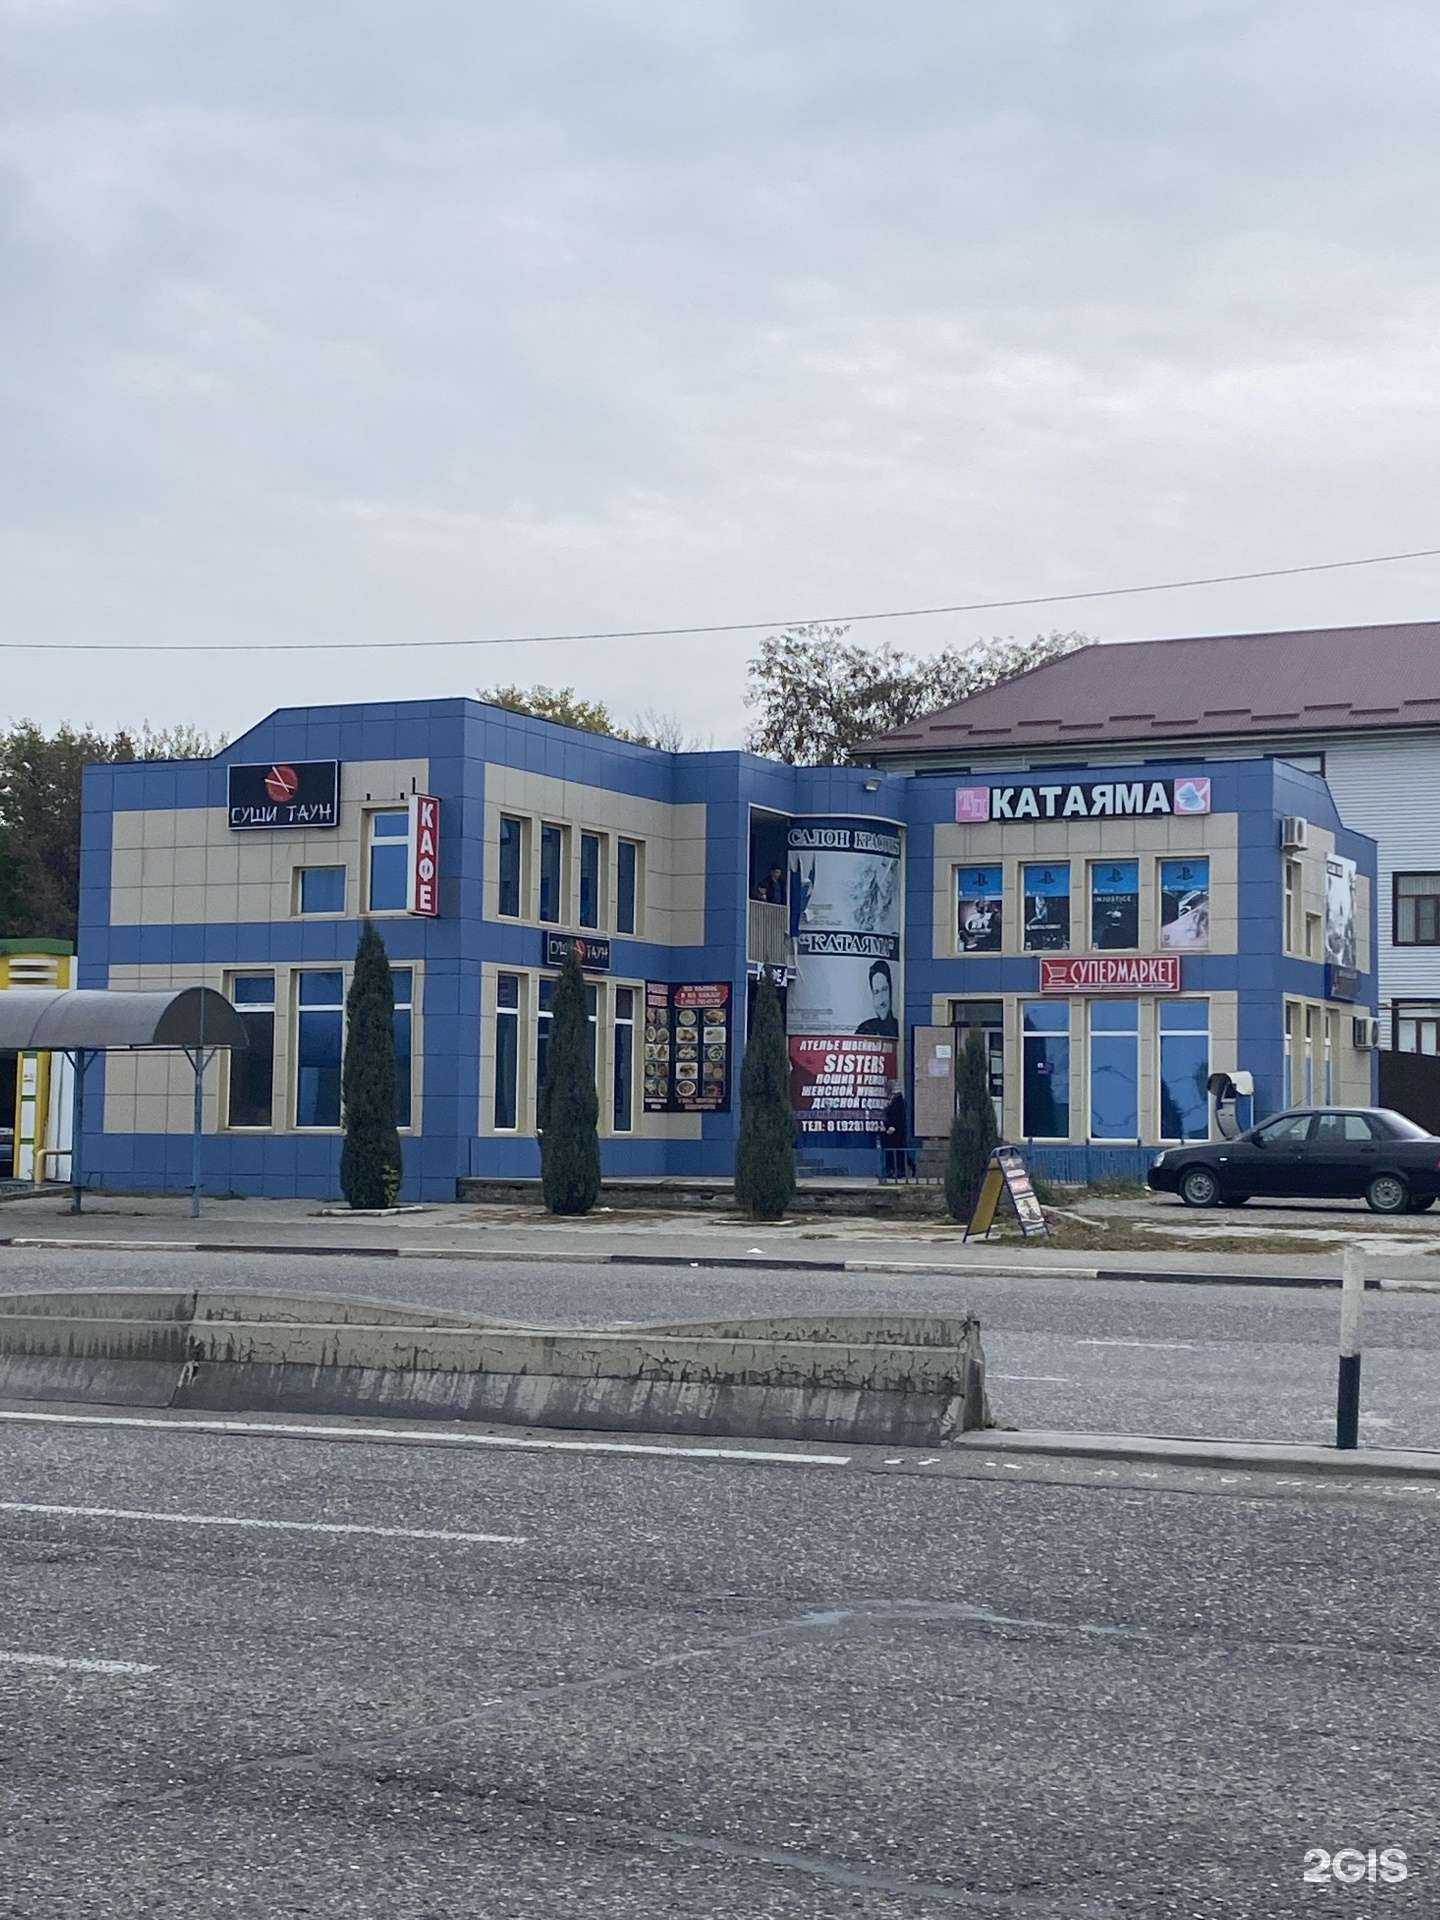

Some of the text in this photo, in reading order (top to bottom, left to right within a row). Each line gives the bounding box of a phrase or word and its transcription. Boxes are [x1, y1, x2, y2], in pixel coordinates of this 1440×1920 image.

[992, 782, 1171, 818] КАТАЯМА
[232, 803, 331, 823] СУШИ ТАУН
[788, 829, 850, 848] САЛОН
[419, 802, 434, 910] КАФЕ
[586, 945, 609, 960] ТАУН
[1071, 960, 1174, 982] СУПЕРМАРКЕТ
[800, 1040, 840, 1051] АТЕЛЬЕ
[824, 1054, 885, 1073] SISTERS
[816, 1074, 855, 1084] ПОШИВ
[802, 1121, 825, 1132] ТЕЛ:
[827, 1121, 835, 1132] 8
